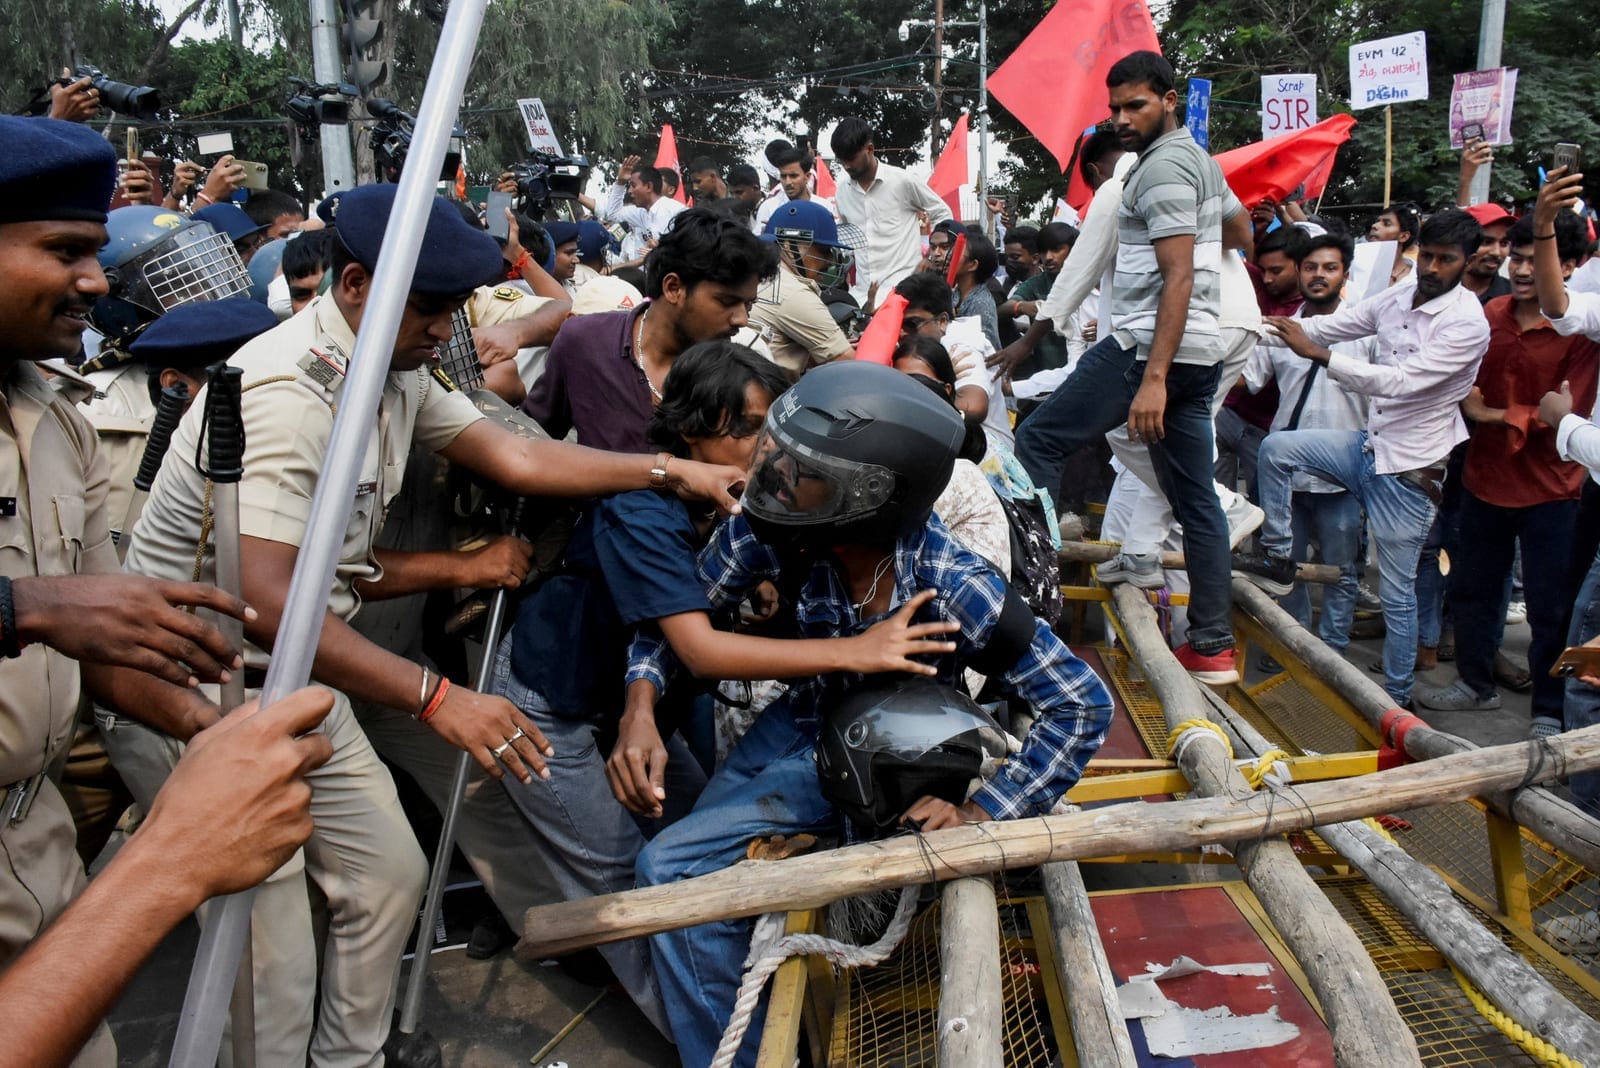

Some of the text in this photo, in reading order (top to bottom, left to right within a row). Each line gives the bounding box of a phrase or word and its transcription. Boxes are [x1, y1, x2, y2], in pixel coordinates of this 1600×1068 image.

[1358, 49, 1383, 61] EVM
[1278, 79, 1304, 93] Scrap
[1266, 98, 1310, 130] SIR
